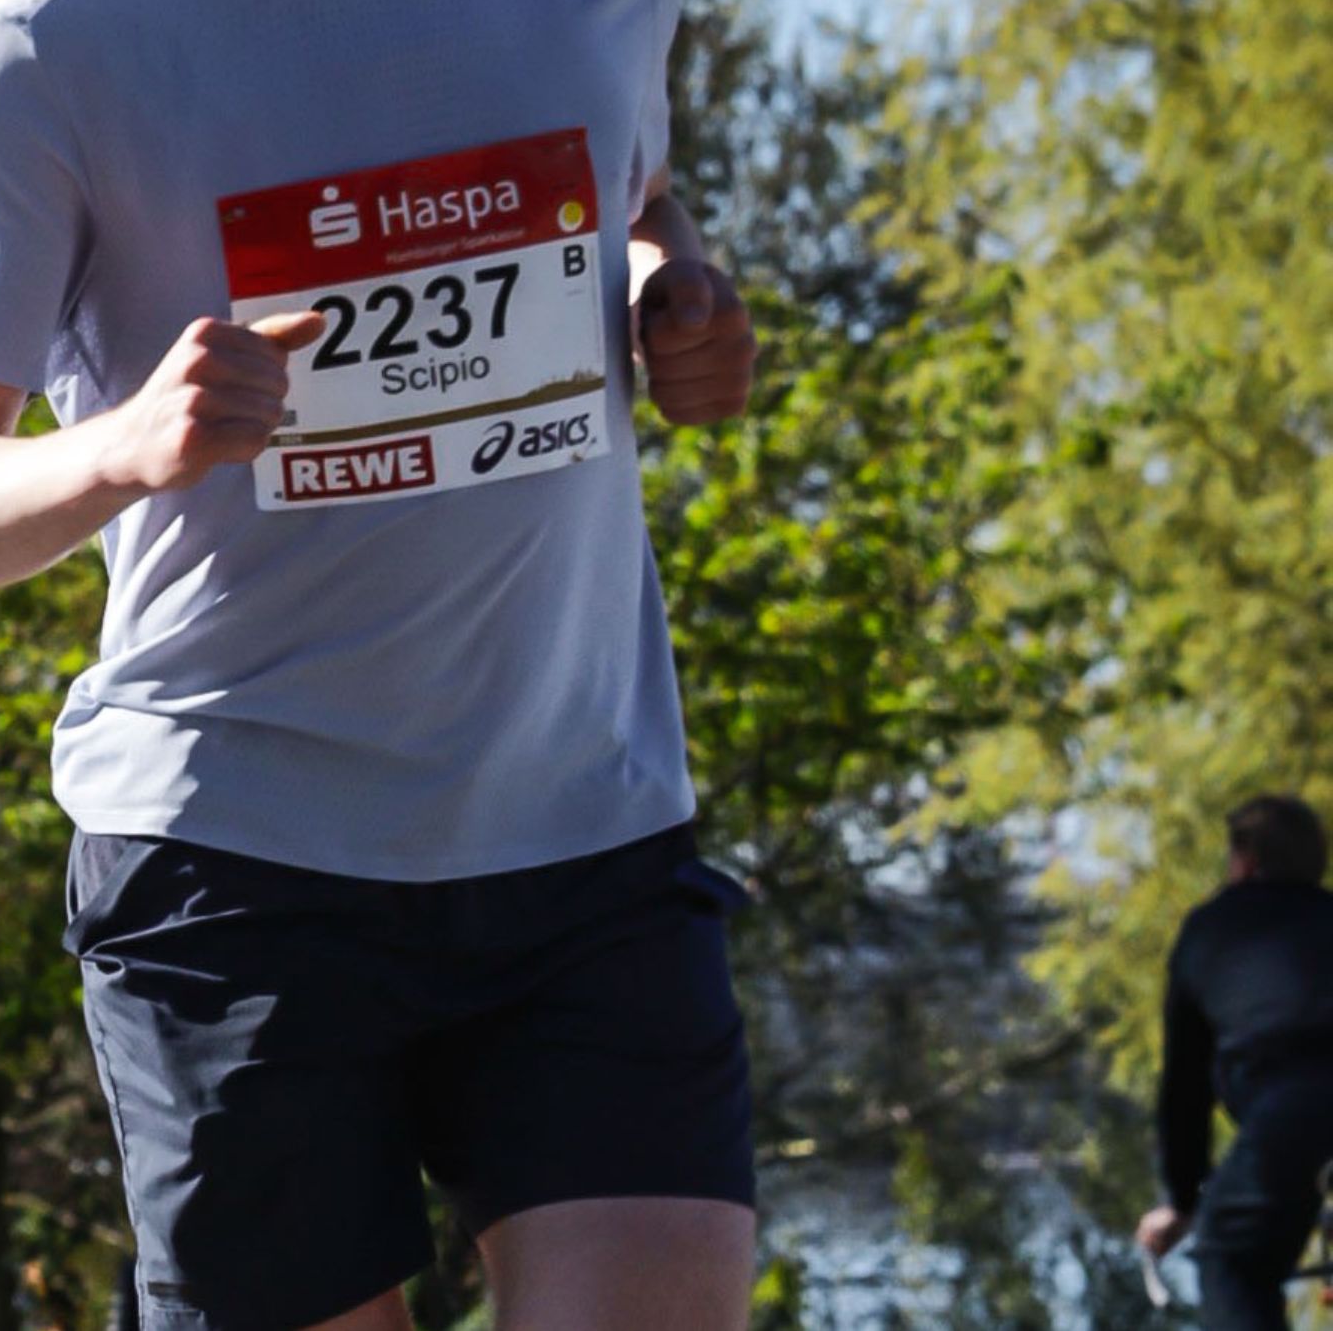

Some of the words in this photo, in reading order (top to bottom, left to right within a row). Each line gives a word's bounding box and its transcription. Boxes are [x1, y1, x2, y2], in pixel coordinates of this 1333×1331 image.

[377, 178, 521, 237] Haspa
[563, 244, 586, 278] B
[310, 262, 520, 372] 2237
[380, 354, 491, 396] Scipio
[289, 444, 428, 494] REWE
